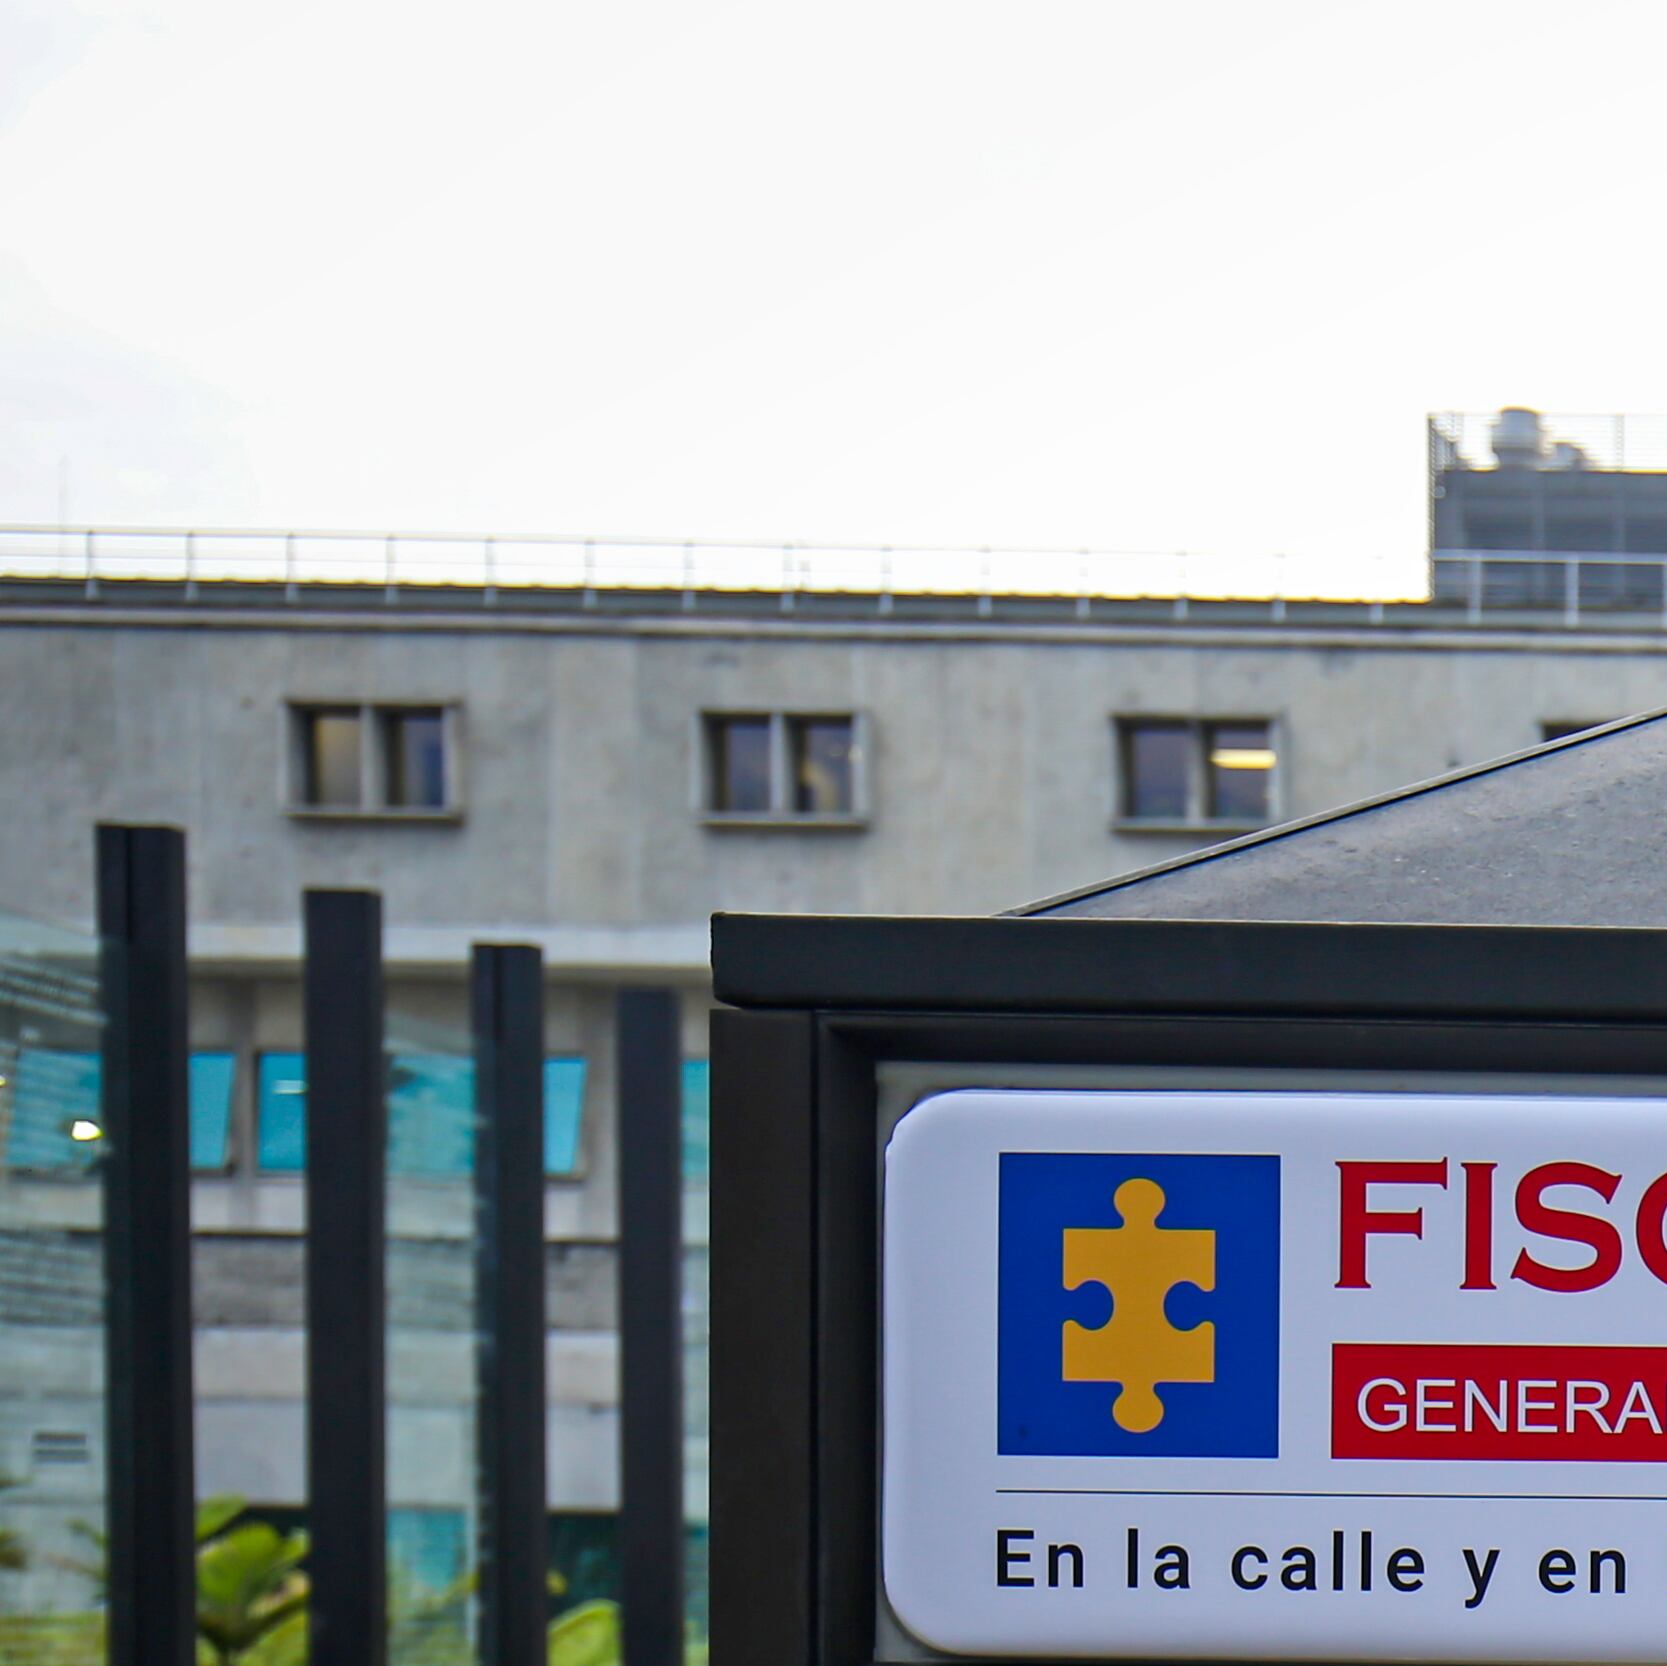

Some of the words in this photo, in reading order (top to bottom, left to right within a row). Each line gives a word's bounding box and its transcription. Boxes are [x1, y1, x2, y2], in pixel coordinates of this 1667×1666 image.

[996, 1528, 1084, 1590] En
[1127, 1526, 1192, 1590] la
[1231, 1530, 1426, 1593] calle
[1461, 1548, 1502, 1611] y
[1538, 1549, 1627, 1595] en
